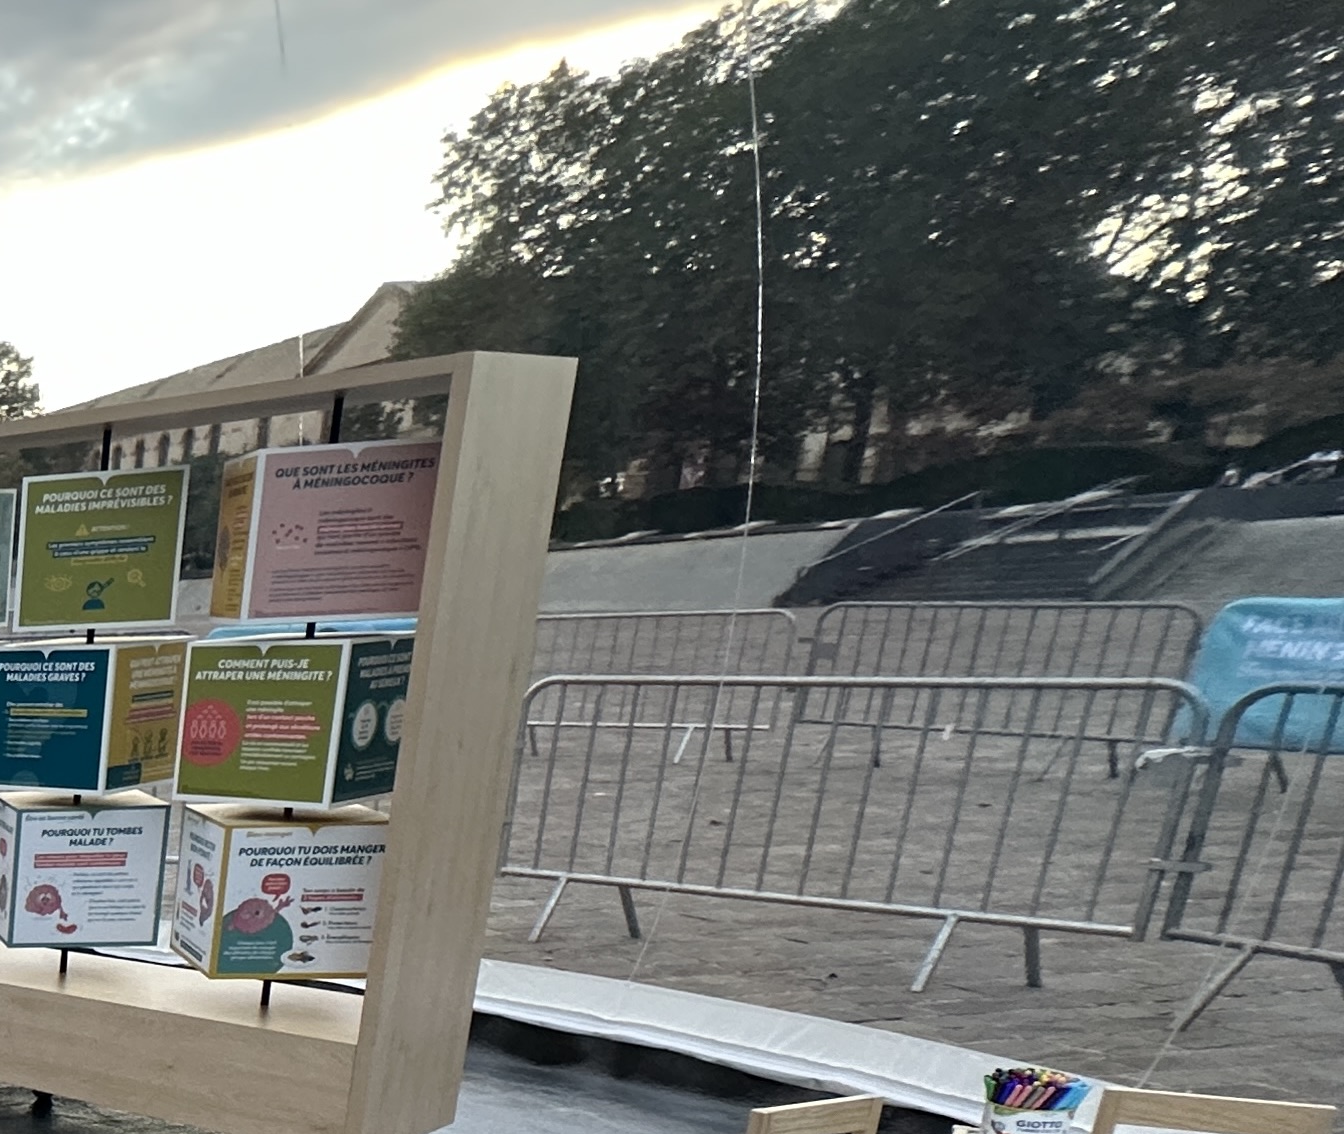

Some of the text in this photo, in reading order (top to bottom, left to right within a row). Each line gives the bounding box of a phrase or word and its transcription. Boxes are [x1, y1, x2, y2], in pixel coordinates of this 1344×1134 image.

[275, 457, 436, 478] QUE SONT LES MÉNINGITES
[292, 472, 414, 490] À MÉNINGOCOQUE ?
[42, 484, 166, 502] POURQUOI CE SONT DES
[34, 494, 174, 514] MALADIES IMPRÉVISIBLES ?
[43, 662, 54, 672] CE
[54, 662, 78, 672] SONT
[78, 662, 96, 672] DES
[218, 658, 310, 669] COMMENT PUIS-JE
[6, 672, 86, 682] MALADIES GRAVES ?
[195, 669, 332, 681] ATTRAPER UNE MÉNINGITE ?
[41, 826, 143, 838] POURQUOI TU TOMBES
[69, 838, 114, 846] MALADE ?
[238, 844, 386, 856] POURQUOI TU DOIS MANGER
[250, 856, 372, 868] DE FAÇON ÉQUILIBRÉE ?
[1016, 1120, 1063, 1128] GIOTTO
